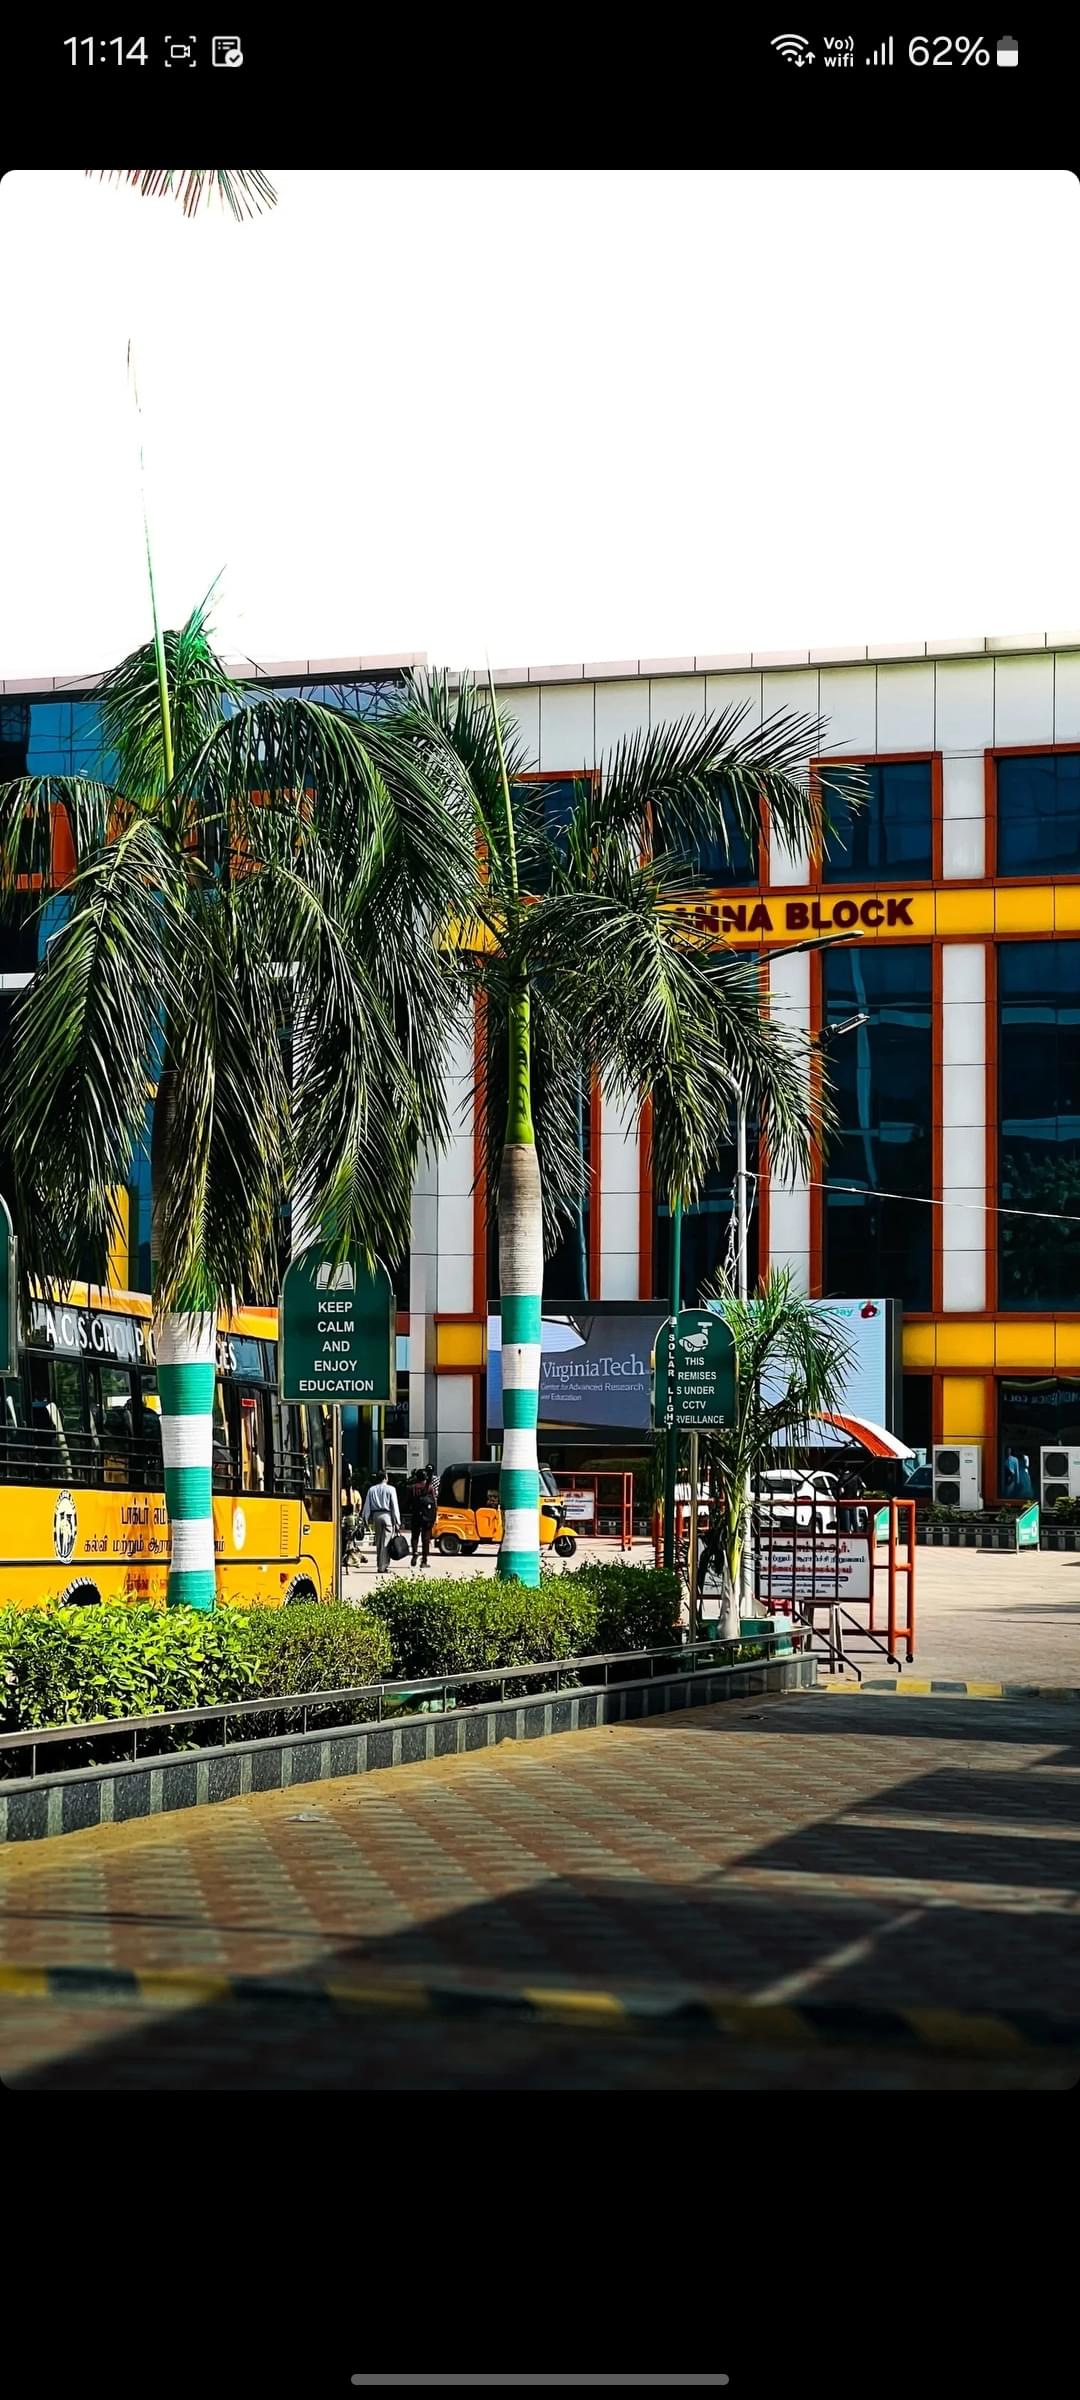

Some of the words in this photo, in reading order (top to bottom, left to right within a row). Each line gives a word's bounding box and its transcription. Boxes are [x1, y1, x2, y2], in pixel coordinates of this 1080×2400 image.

[785, 897, 914, 930] BLOCK
[318, 1301, 353, 1313] KEEP
[317, 1321, 355, 1333] CALM
[322, 1340, 351, 1352] AND
[667, 1333, 676, 1377] SOLAR
[314, 1360, 358, 1372] ENJOY
[684, 1357, 705, 1366] THIS
[677, 1371, 717, 1380] REMISES
[299, 1380, 374, 1392] EDUCATION
[569, 1383, 603, 1391] Advanced
[604, 1382, 644, 1391] Research
[676, 1386, 682, 1395] S
[684, 1386, 715, 1394] UNDER
[666, 1386, 675, 1430] LIGHT
[682, 1400, 707, 1409] CCTV
[84, 1535, 108, 1553] கல்வி
[112, 1534, 145, 1556] மற்றும்
